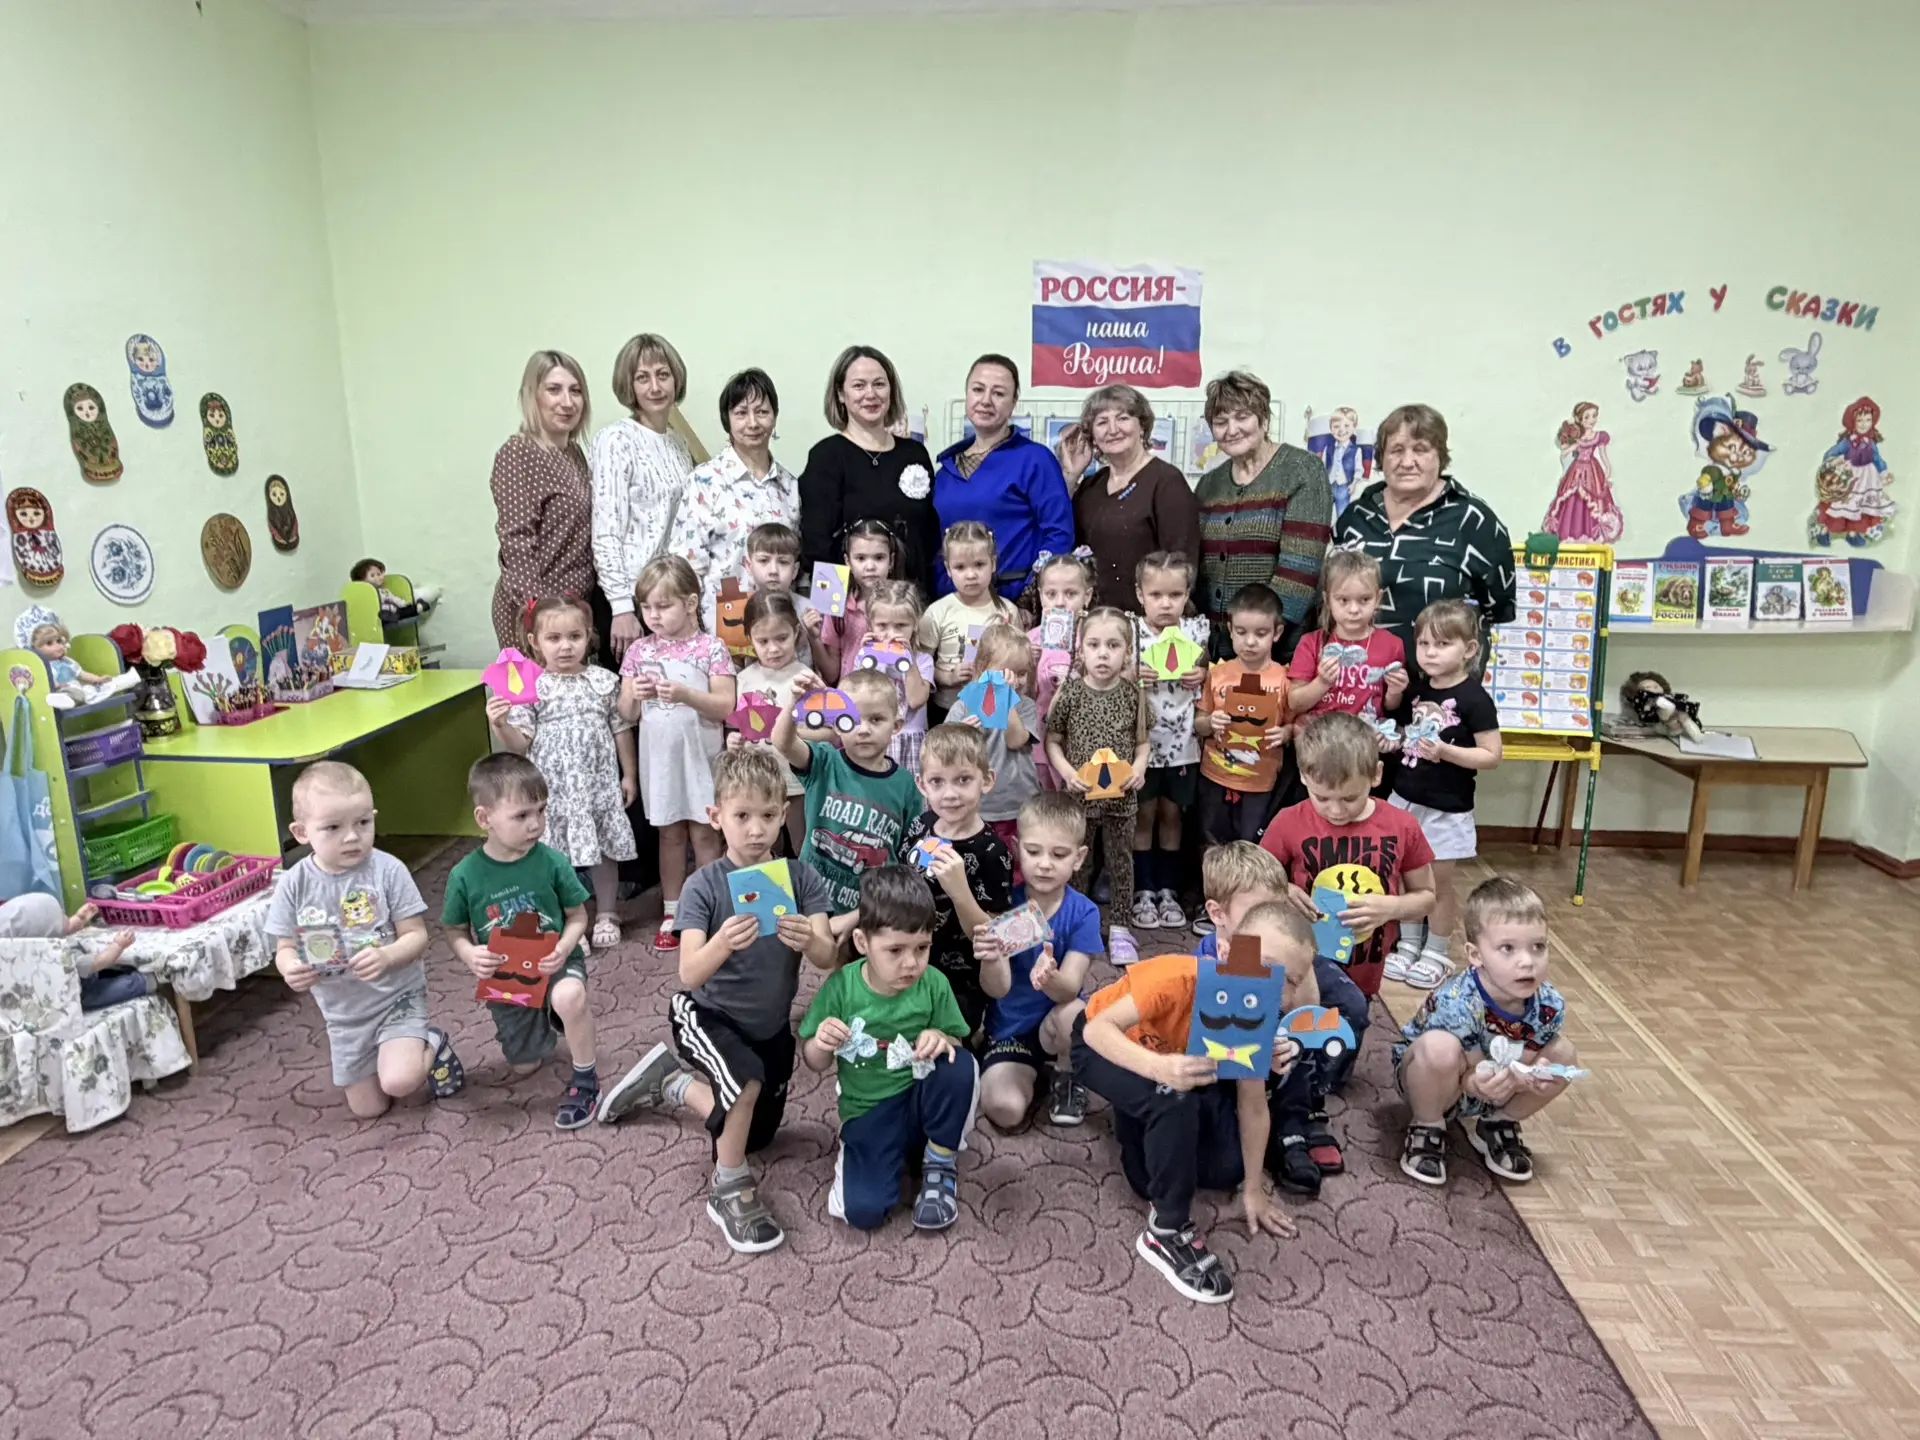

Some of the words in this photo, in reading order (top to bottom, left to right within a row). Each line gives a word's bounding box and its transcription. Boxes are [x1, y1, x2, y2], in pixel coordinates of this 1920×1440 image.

[1041, 276, 1186, 303] РОССИЯ-
[1086, 321, 1150, 339] наша
[1588, 290, 1686, 340] ГОСТЯХ
[1709, 283, 1728, 312] У
[1766, 286, 1880, 331] СКАЗКИ
[1063, 341, 1164, 384] Родина!
[820, 795, 864, 827] ROAD
[1301, 835, 1398, 892] SMILE
